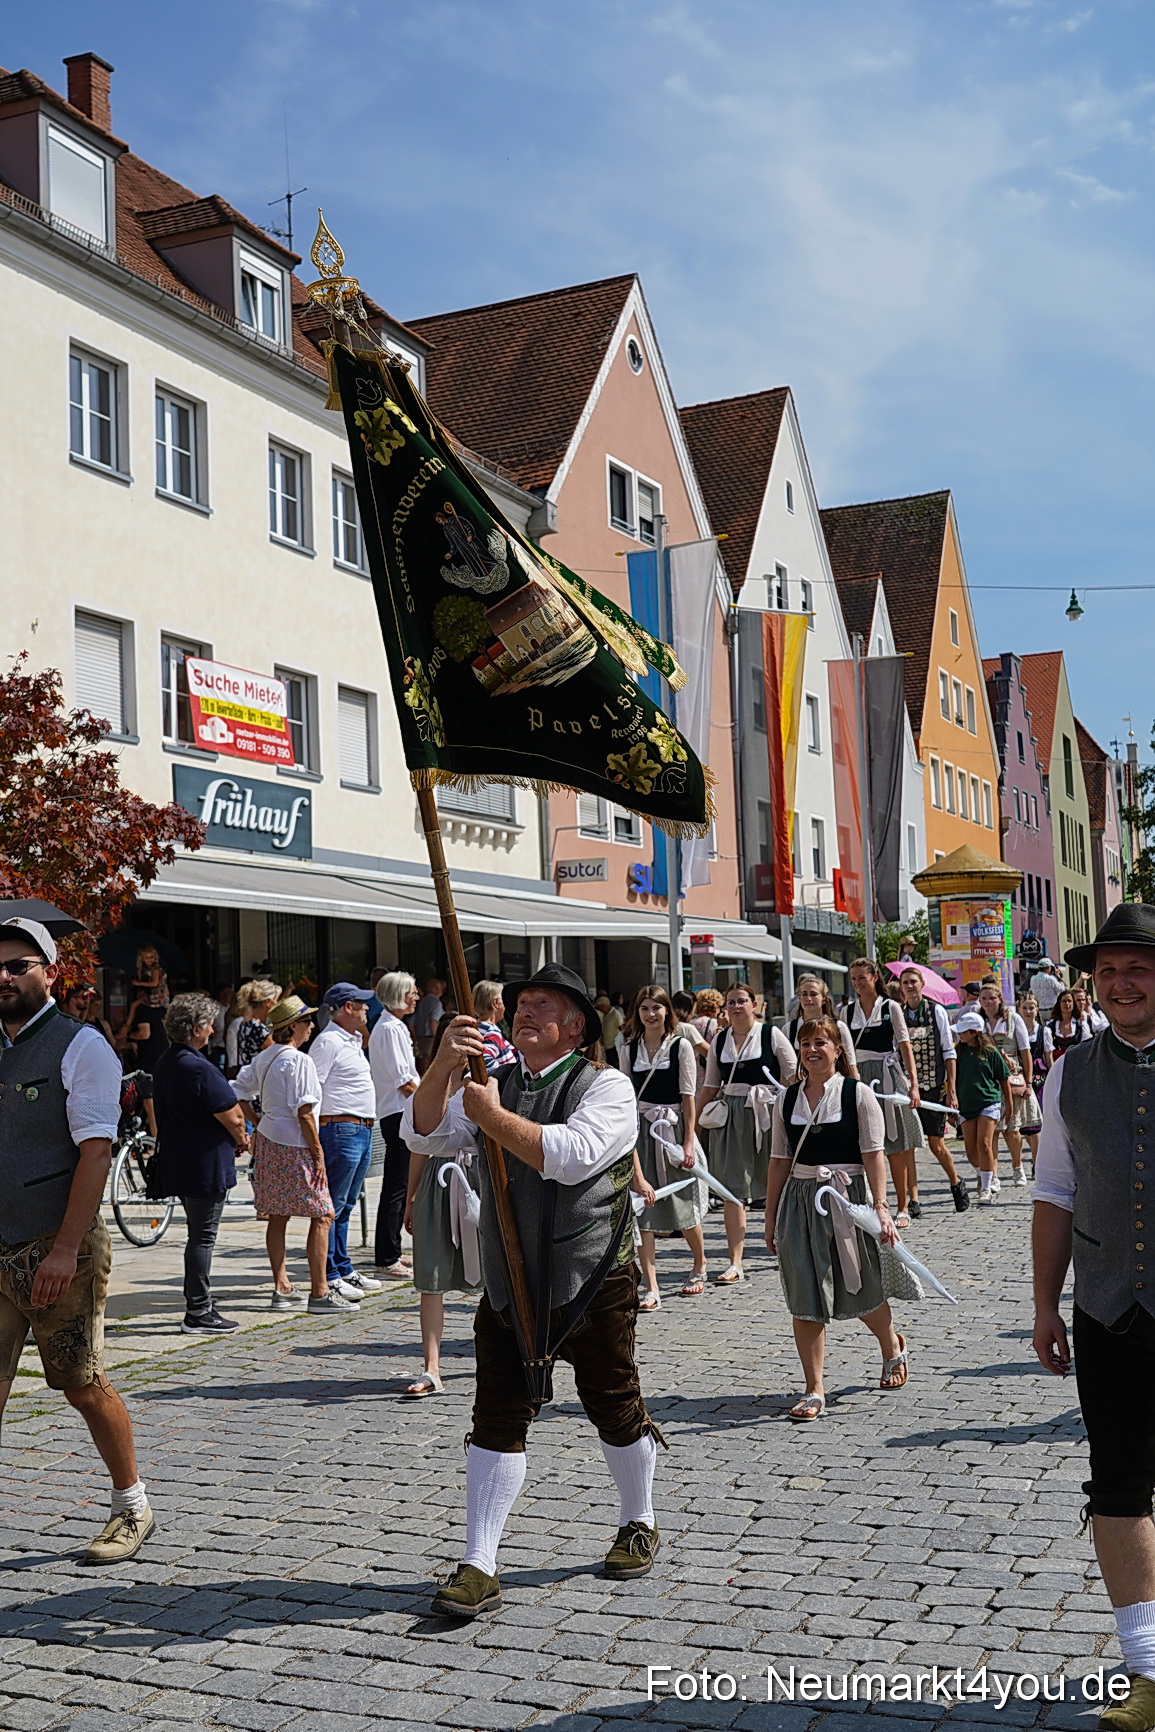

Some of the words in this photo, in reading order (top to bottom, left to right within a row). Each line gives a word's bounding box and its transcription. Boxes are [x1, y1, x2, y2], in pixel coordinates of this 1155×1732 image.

[193, 669, 240, 695] Suche
[610, 704, 644, 739] Renoviert
[626, 724, 649, 744] 1996
[236, 738, 256, 752] 09181
[262, 744, 276, 756] 509
[276, 746, 290, 759] 390
[198, 778, 309, 849] frühauf
[972, 925, 1004, 937] VOLKSFEST
